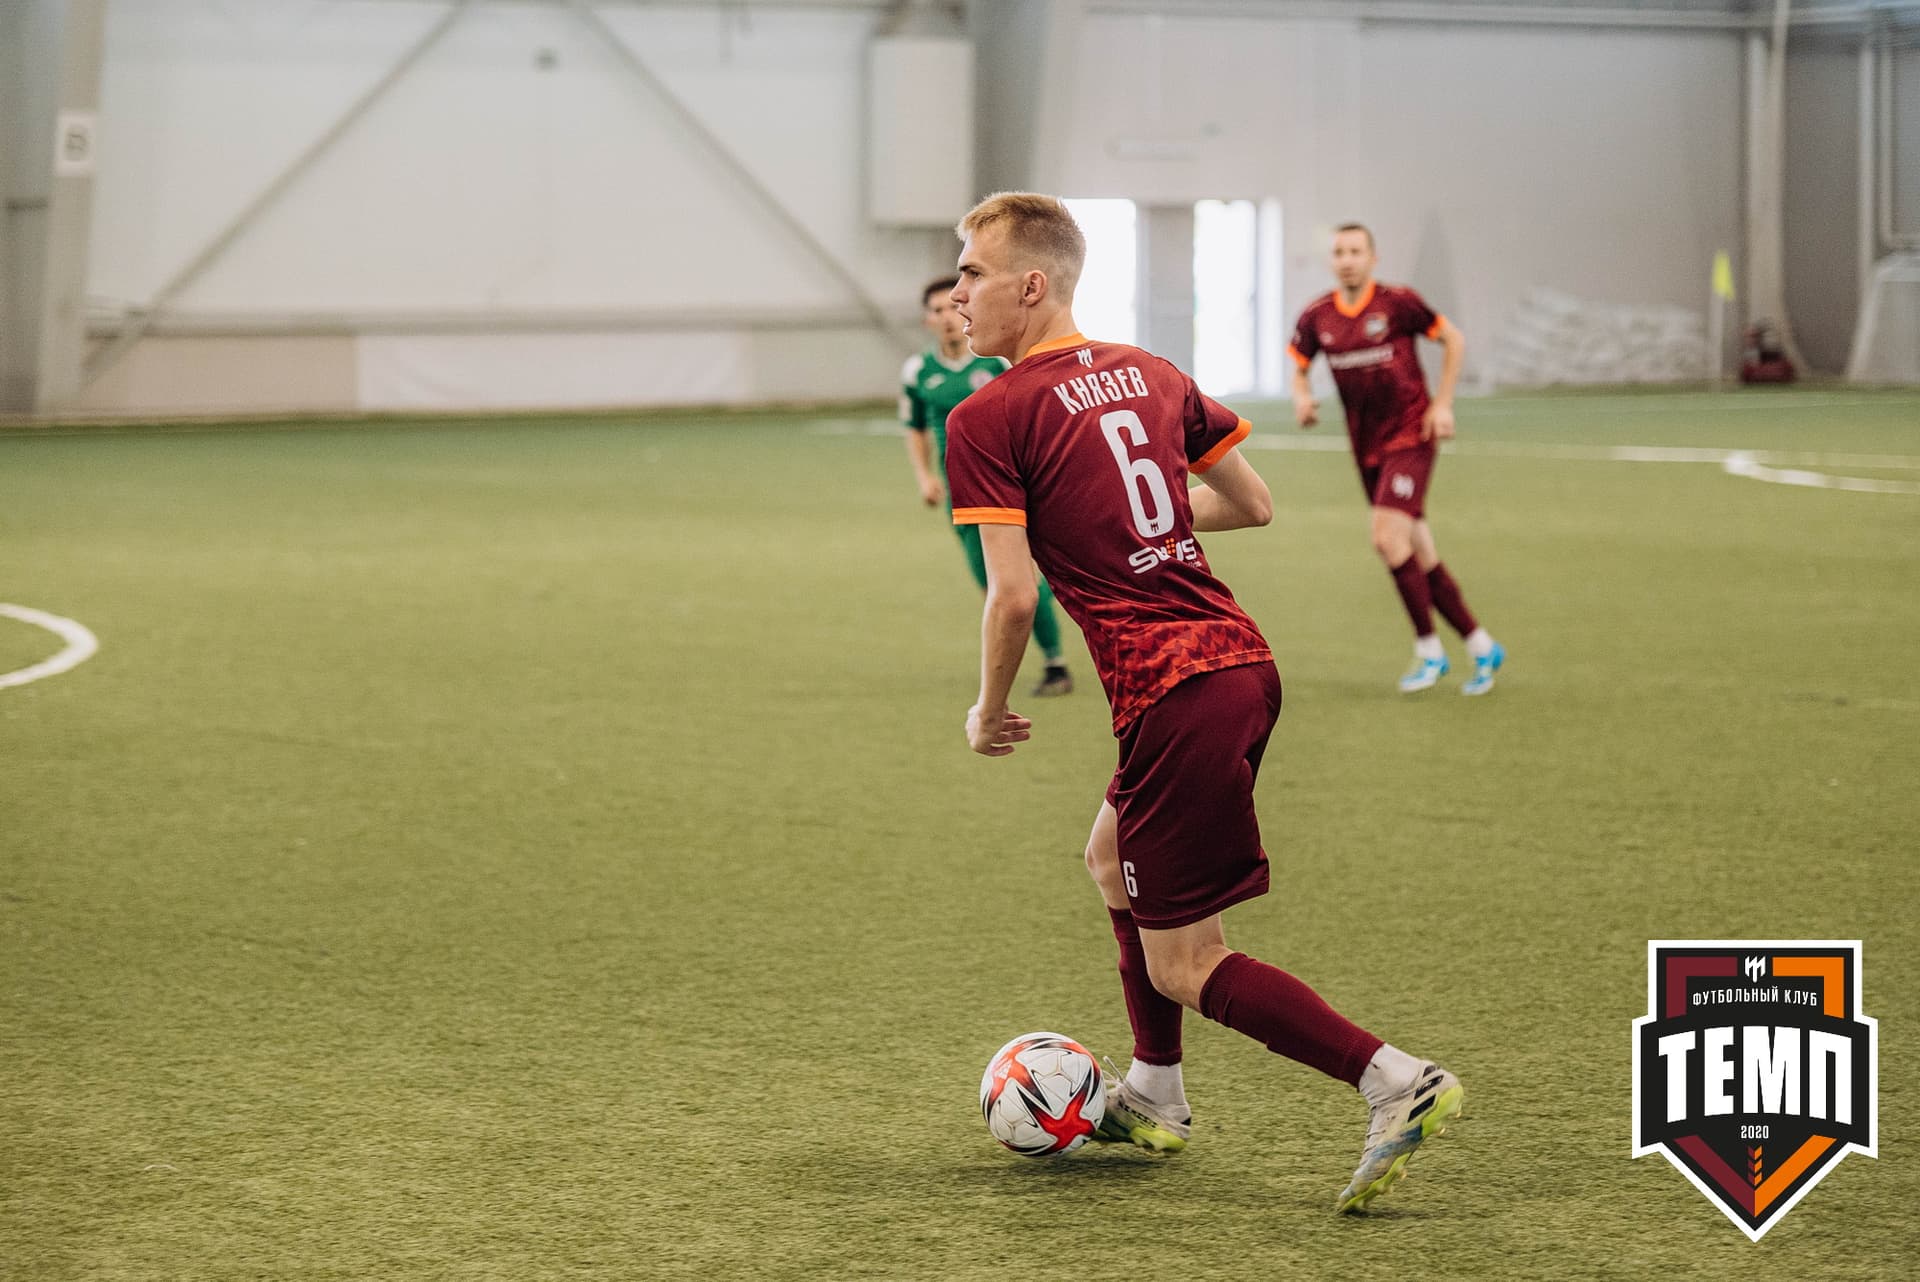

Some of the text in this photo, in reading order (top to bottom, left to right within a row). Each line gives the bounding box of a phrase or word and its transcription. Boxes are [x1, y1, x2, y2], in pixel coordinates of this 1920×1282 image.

[1053, 366, 1149, 415] КНЯЗЕВ
[1099, 409, 1175, 538] 6
[1123, 860, 1138, 898] 6
